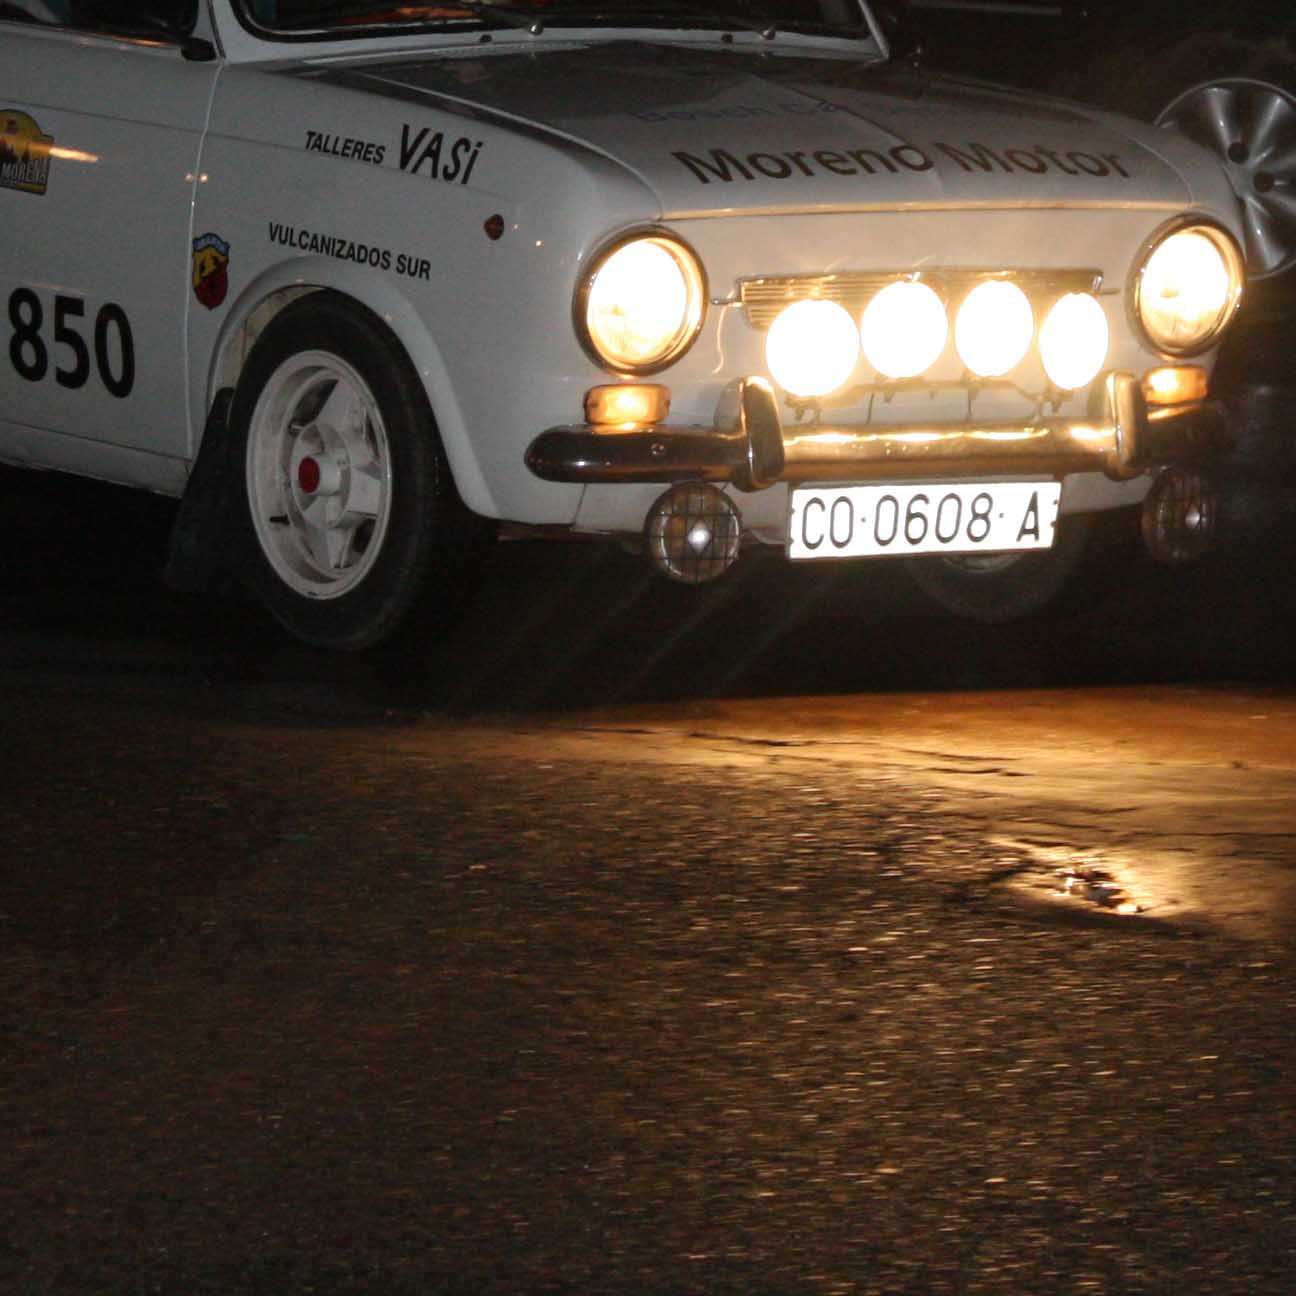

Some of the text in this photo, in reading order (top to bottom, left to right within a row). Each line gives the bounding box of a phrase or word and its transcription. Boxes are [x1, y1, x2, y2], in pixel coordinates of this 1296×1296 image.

[305, 131, 386, 164] TALLERES
[671, 142, 1132, 184] Moreno Motor
[268, 222, 392, 270] VULCANIZADOS
[395, 254, 432, 281] SUR
[9, 288, 135, 398] 850
